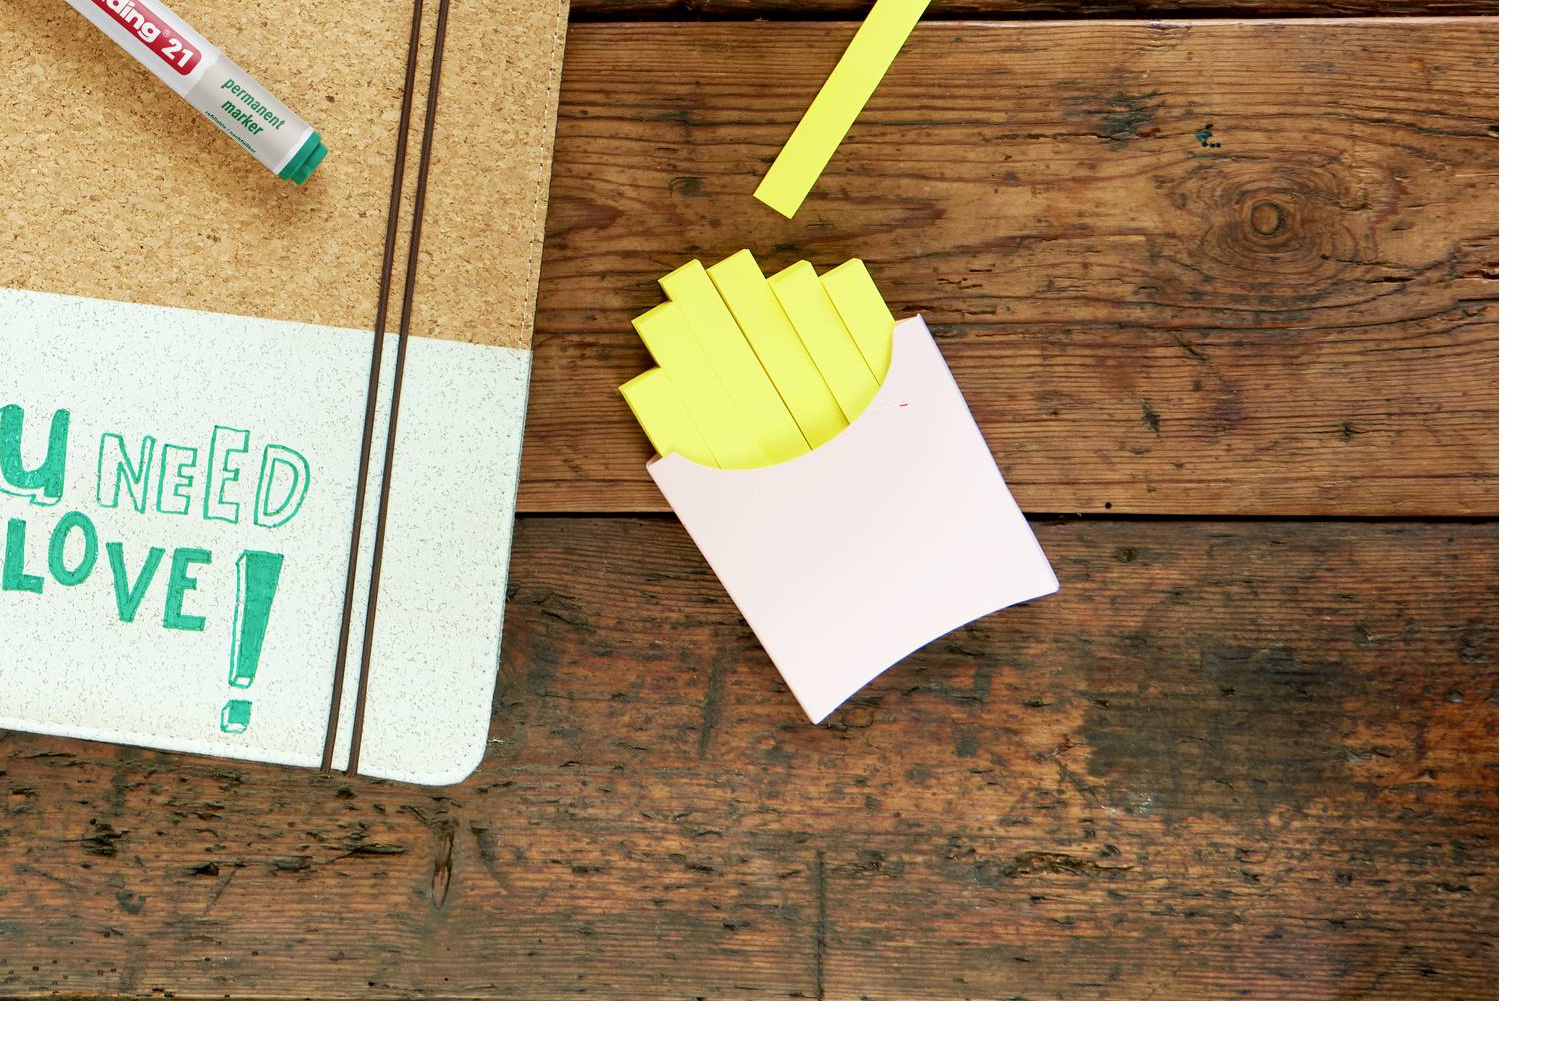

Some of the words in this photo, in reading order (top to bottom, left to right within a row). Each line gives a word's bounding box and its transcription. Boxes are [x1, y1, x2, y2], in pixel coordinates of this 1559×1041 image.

[160, 38, 194, 68] 21
[220, 78, 286, 131] permanent
[220, 100, 265, 135] marker
[96, 425, 310, 528] NEED
